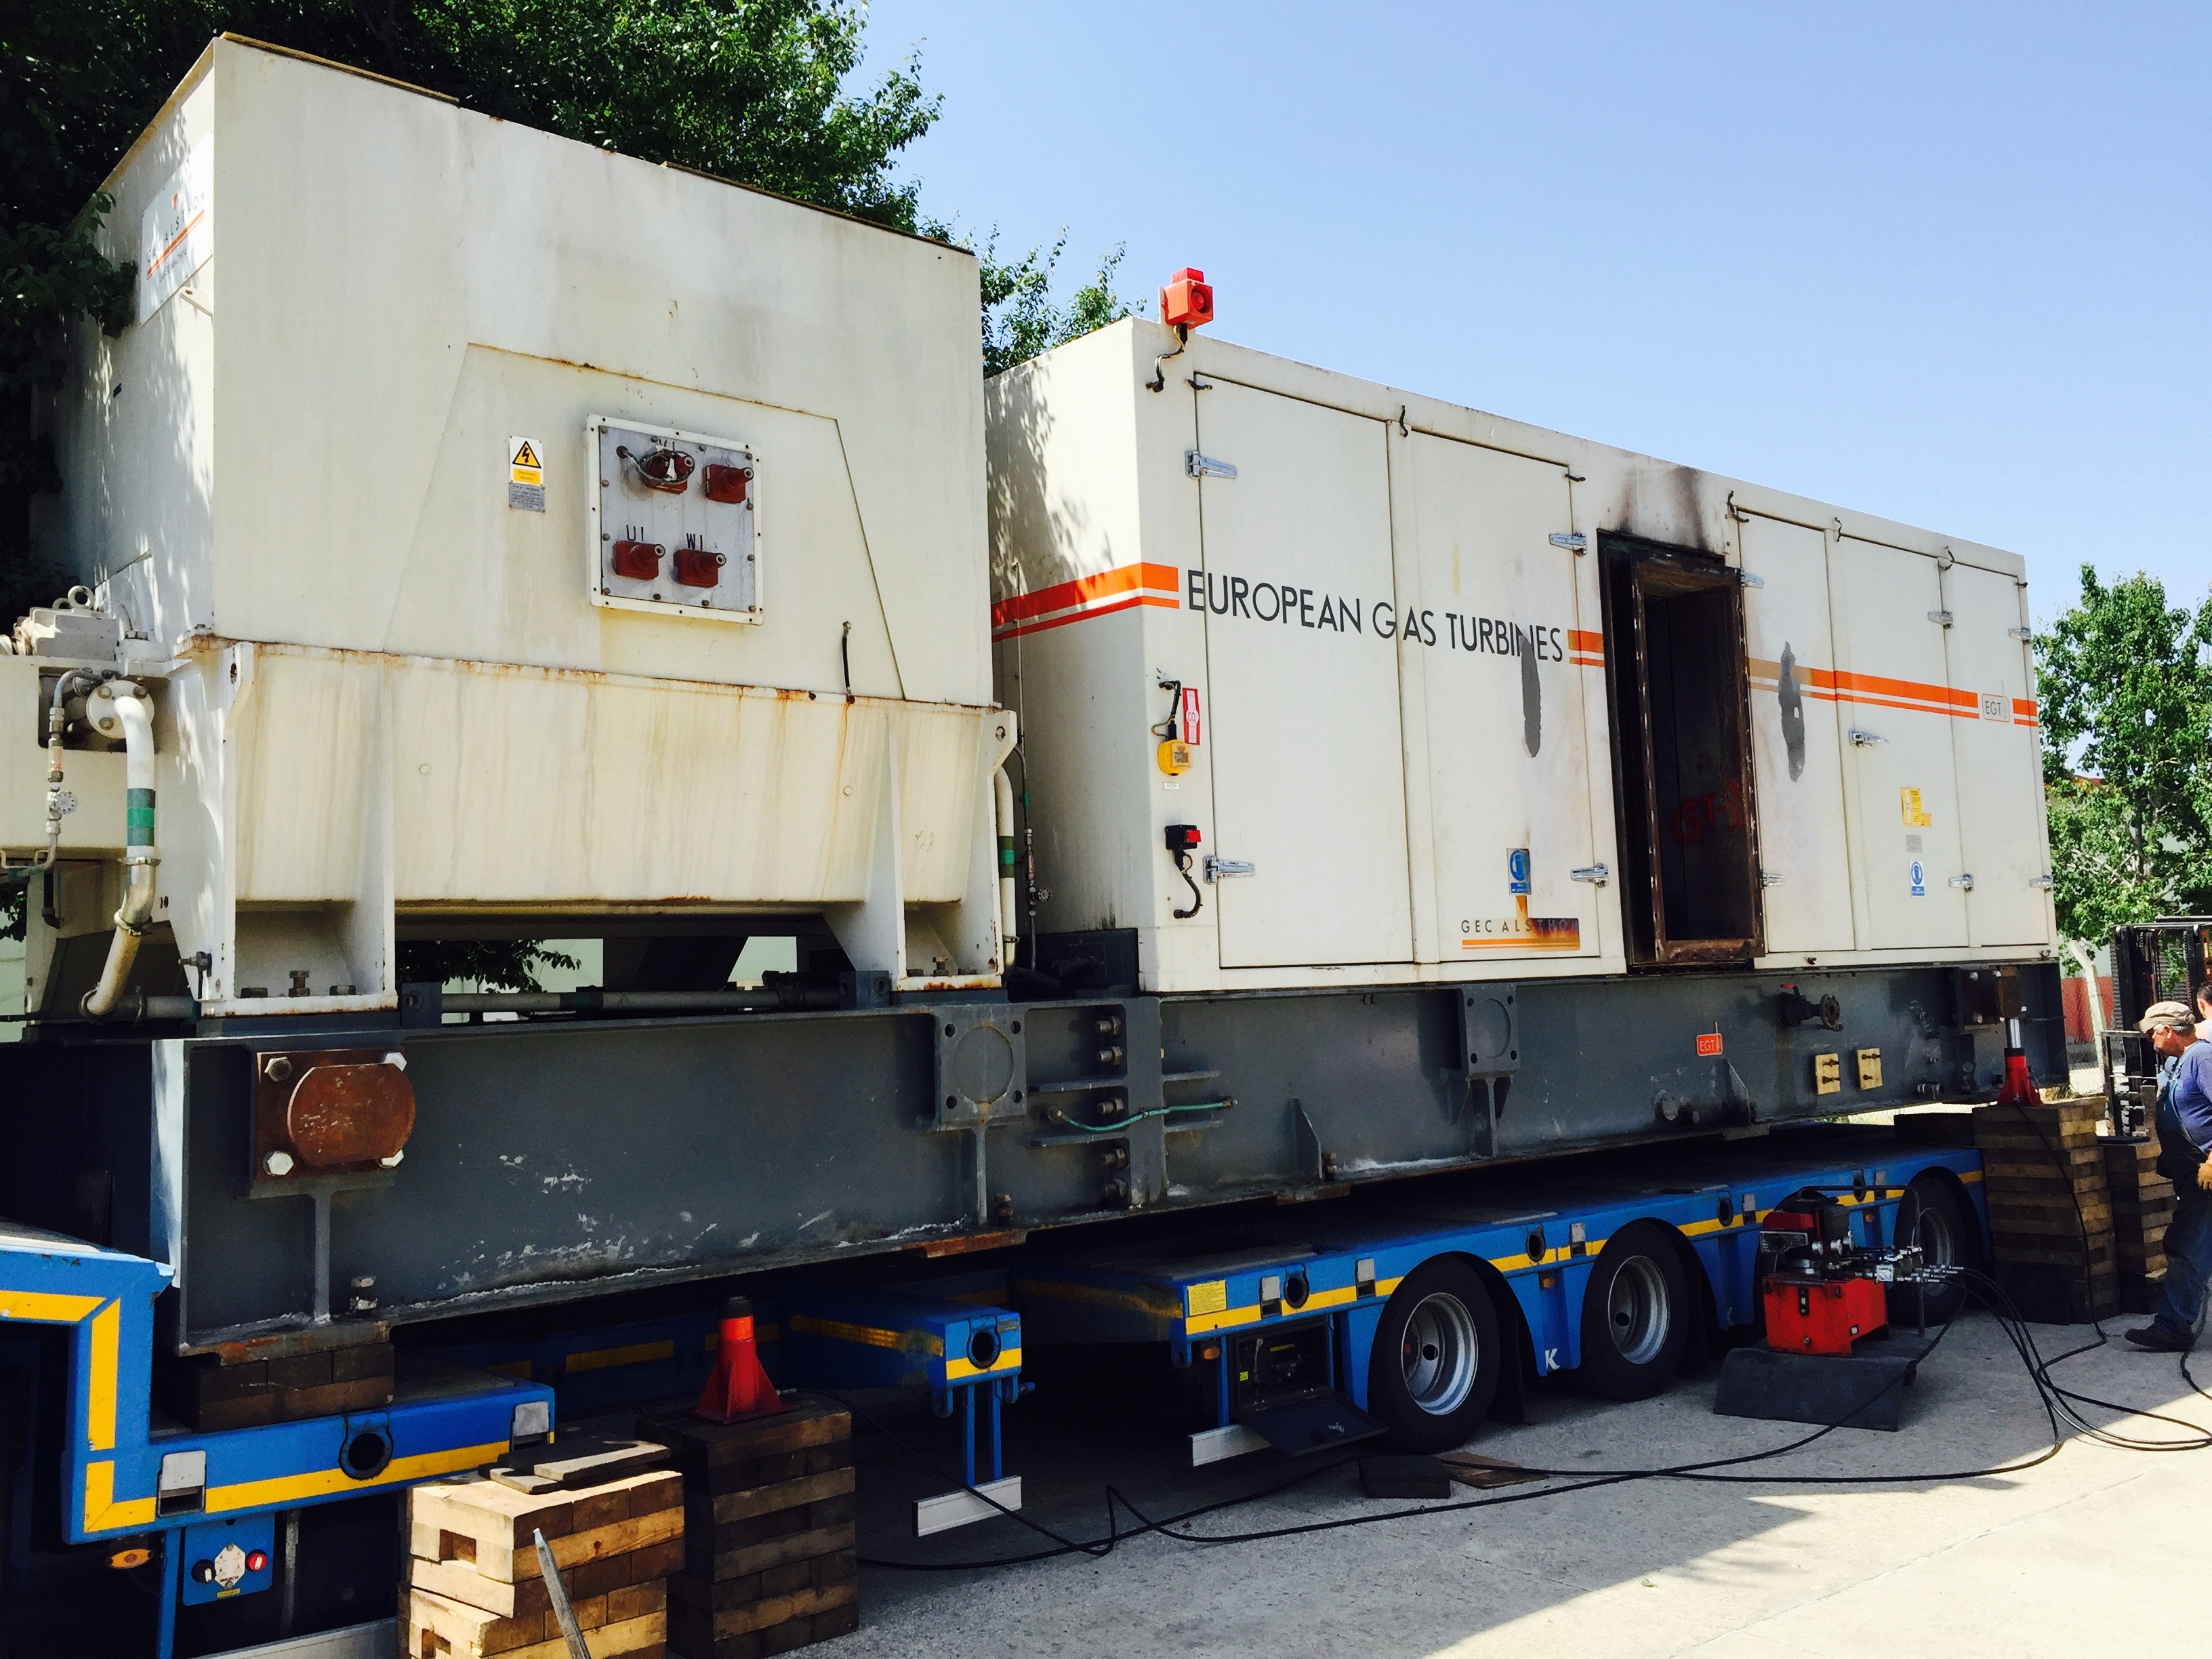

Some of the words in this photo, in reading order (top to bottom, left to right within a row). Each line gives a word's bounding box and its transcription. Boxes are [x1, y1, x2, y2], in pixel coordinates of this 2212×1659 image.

[1187, 569, 1361, 634] EUROPEAN
[1372, 602, 1437, 647] GAS
[1446, 613, 1563, 662] TURBINES
[1985, 701, 2001, 716] EGT
[1461, 919, 1492, 933] GEC
[1700, 1039, 1715, 1051] EGT
[1544, 1347, 1560, 1370] K
